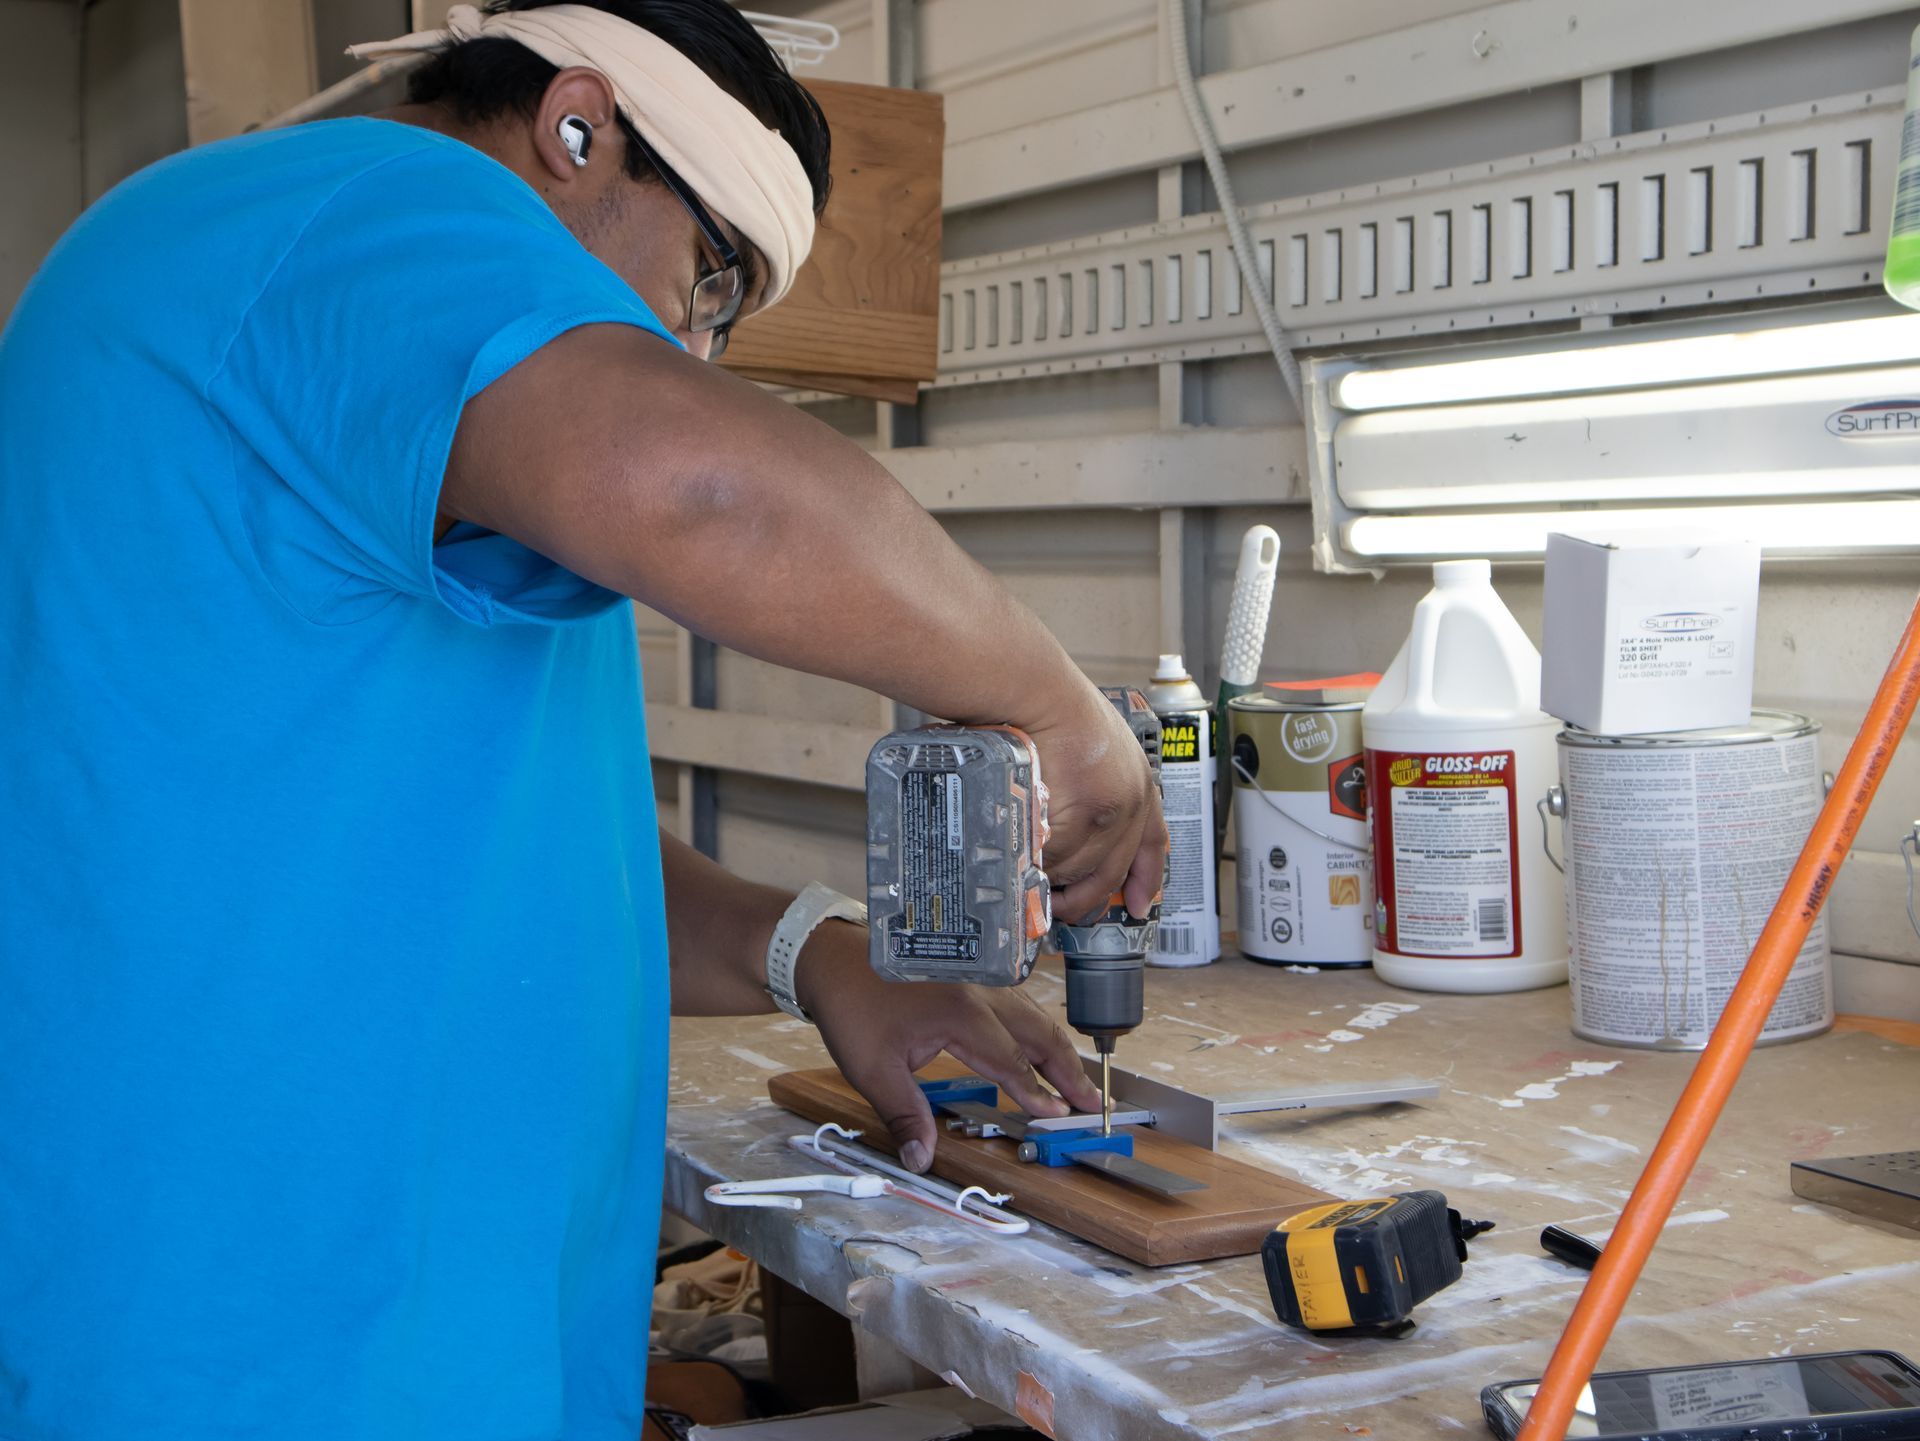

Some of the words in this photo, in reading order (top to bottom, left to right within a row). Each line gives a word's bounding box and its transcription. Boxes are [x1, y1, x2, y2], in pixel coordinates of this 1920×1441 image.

[1645, 617, 1720, 631] SurfPrep
[1664, 635, 1685, 643] HOOK
[1695, 634, 1715, 642] LOOP
[1619, 653, 1637, 662] 320
[1640, 652, 1658, 662] Grit
[1294, 716, 1318, 734] fast
[1292, 730, 1330, 751] drying
[1425, 754, 1509, 773] GLOSS-OFF
[1326, 852, 1354, 860] Interior
[1806, 863, 1833, 911] HUSKY
